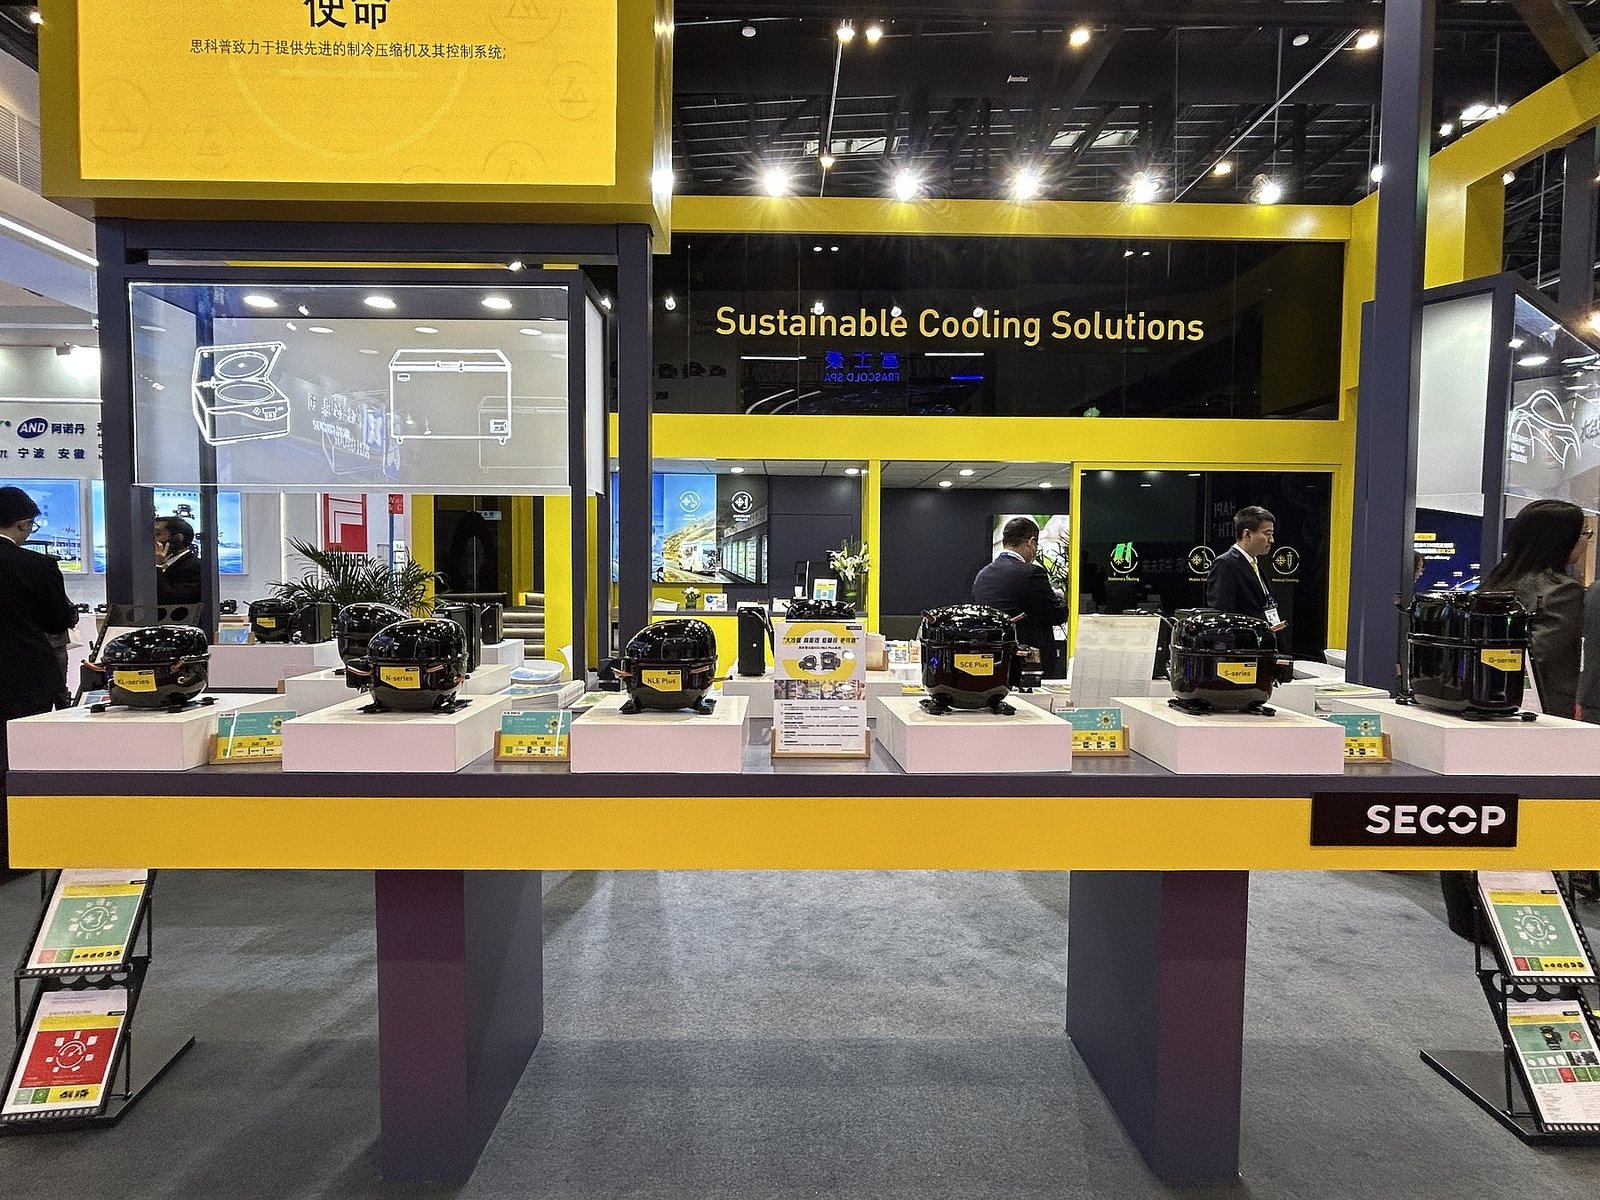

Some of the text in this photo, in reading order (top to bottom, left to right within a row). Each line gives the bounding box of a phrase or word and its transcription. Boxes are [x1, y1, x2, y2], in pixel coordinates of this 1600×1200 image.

[306, 0, 391, 29] 使命
[716, 306, 1204, 347] Sustainable Cooling Solutions
[20, 422, 46, 434] AND
[51, 423, 86, 434] 阿诺丹
[385, 674, 414, 682] N-series
[1364, 804, 1507, 835] SECOP
